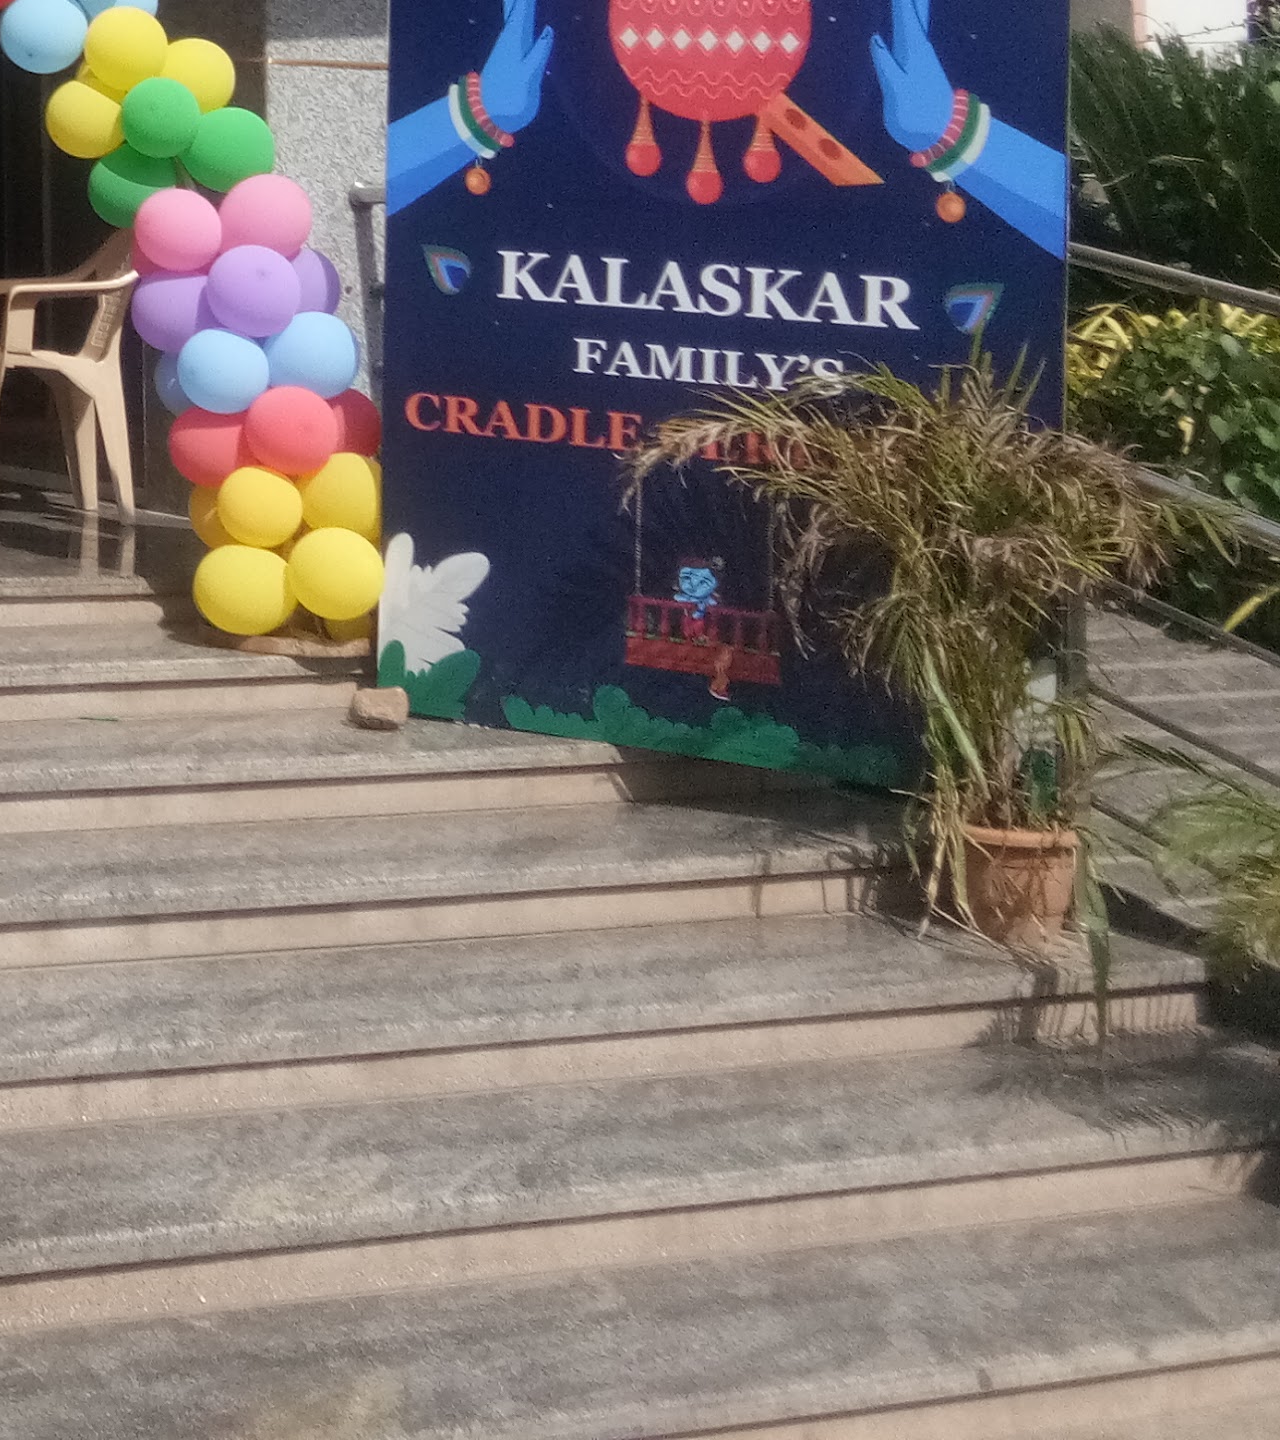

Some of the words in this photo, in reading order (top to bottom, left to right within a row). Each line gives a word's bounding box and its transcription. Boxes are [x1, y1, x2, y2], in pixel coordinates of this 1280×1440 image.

[496, 250, 920, 331] KALASKAR
[572, 336, 845, 394] FAMILY'S
[404, 392, 643, 453] CRADLE
